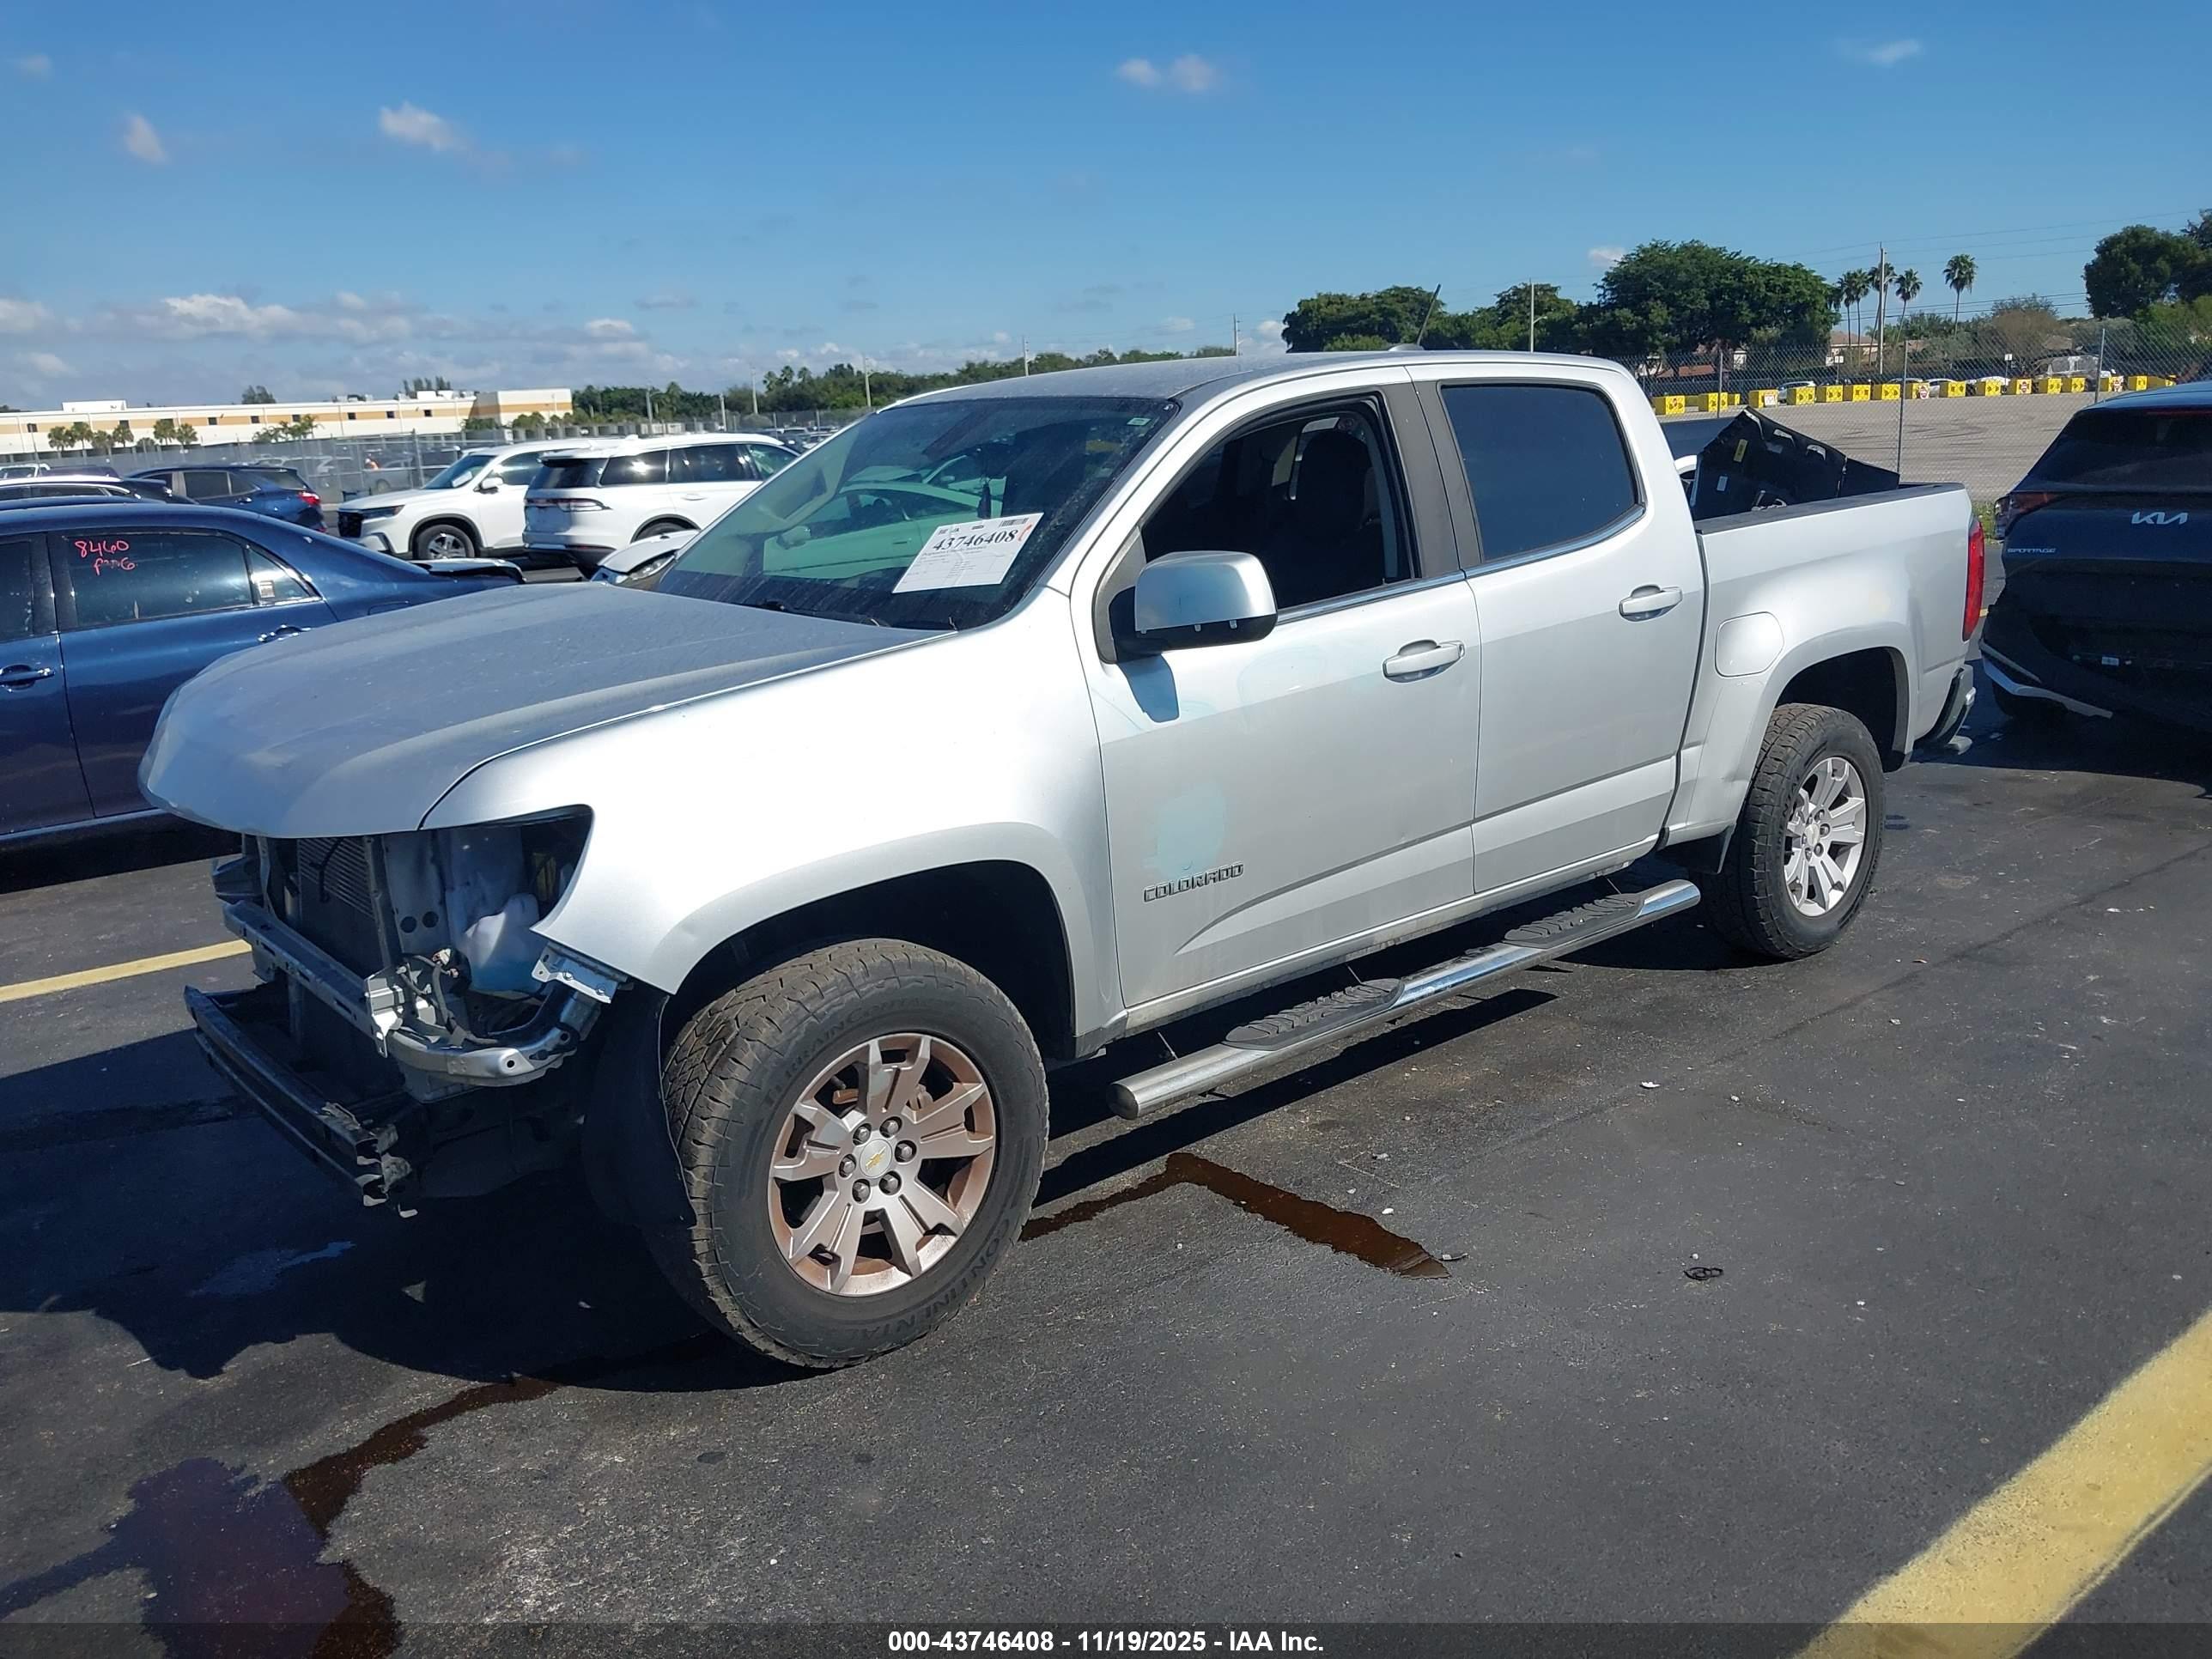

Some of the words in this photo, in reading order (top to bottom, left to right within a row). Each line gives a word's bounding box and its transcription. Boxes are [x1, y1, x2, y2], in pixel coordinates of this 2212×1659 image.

[2130, 511, 2189, 525] KIA
[75, 540, 130, 558] 8460
[933, 529, 1019, 551] 43746408
[1143, 861, 1244, 902] COLORADO
